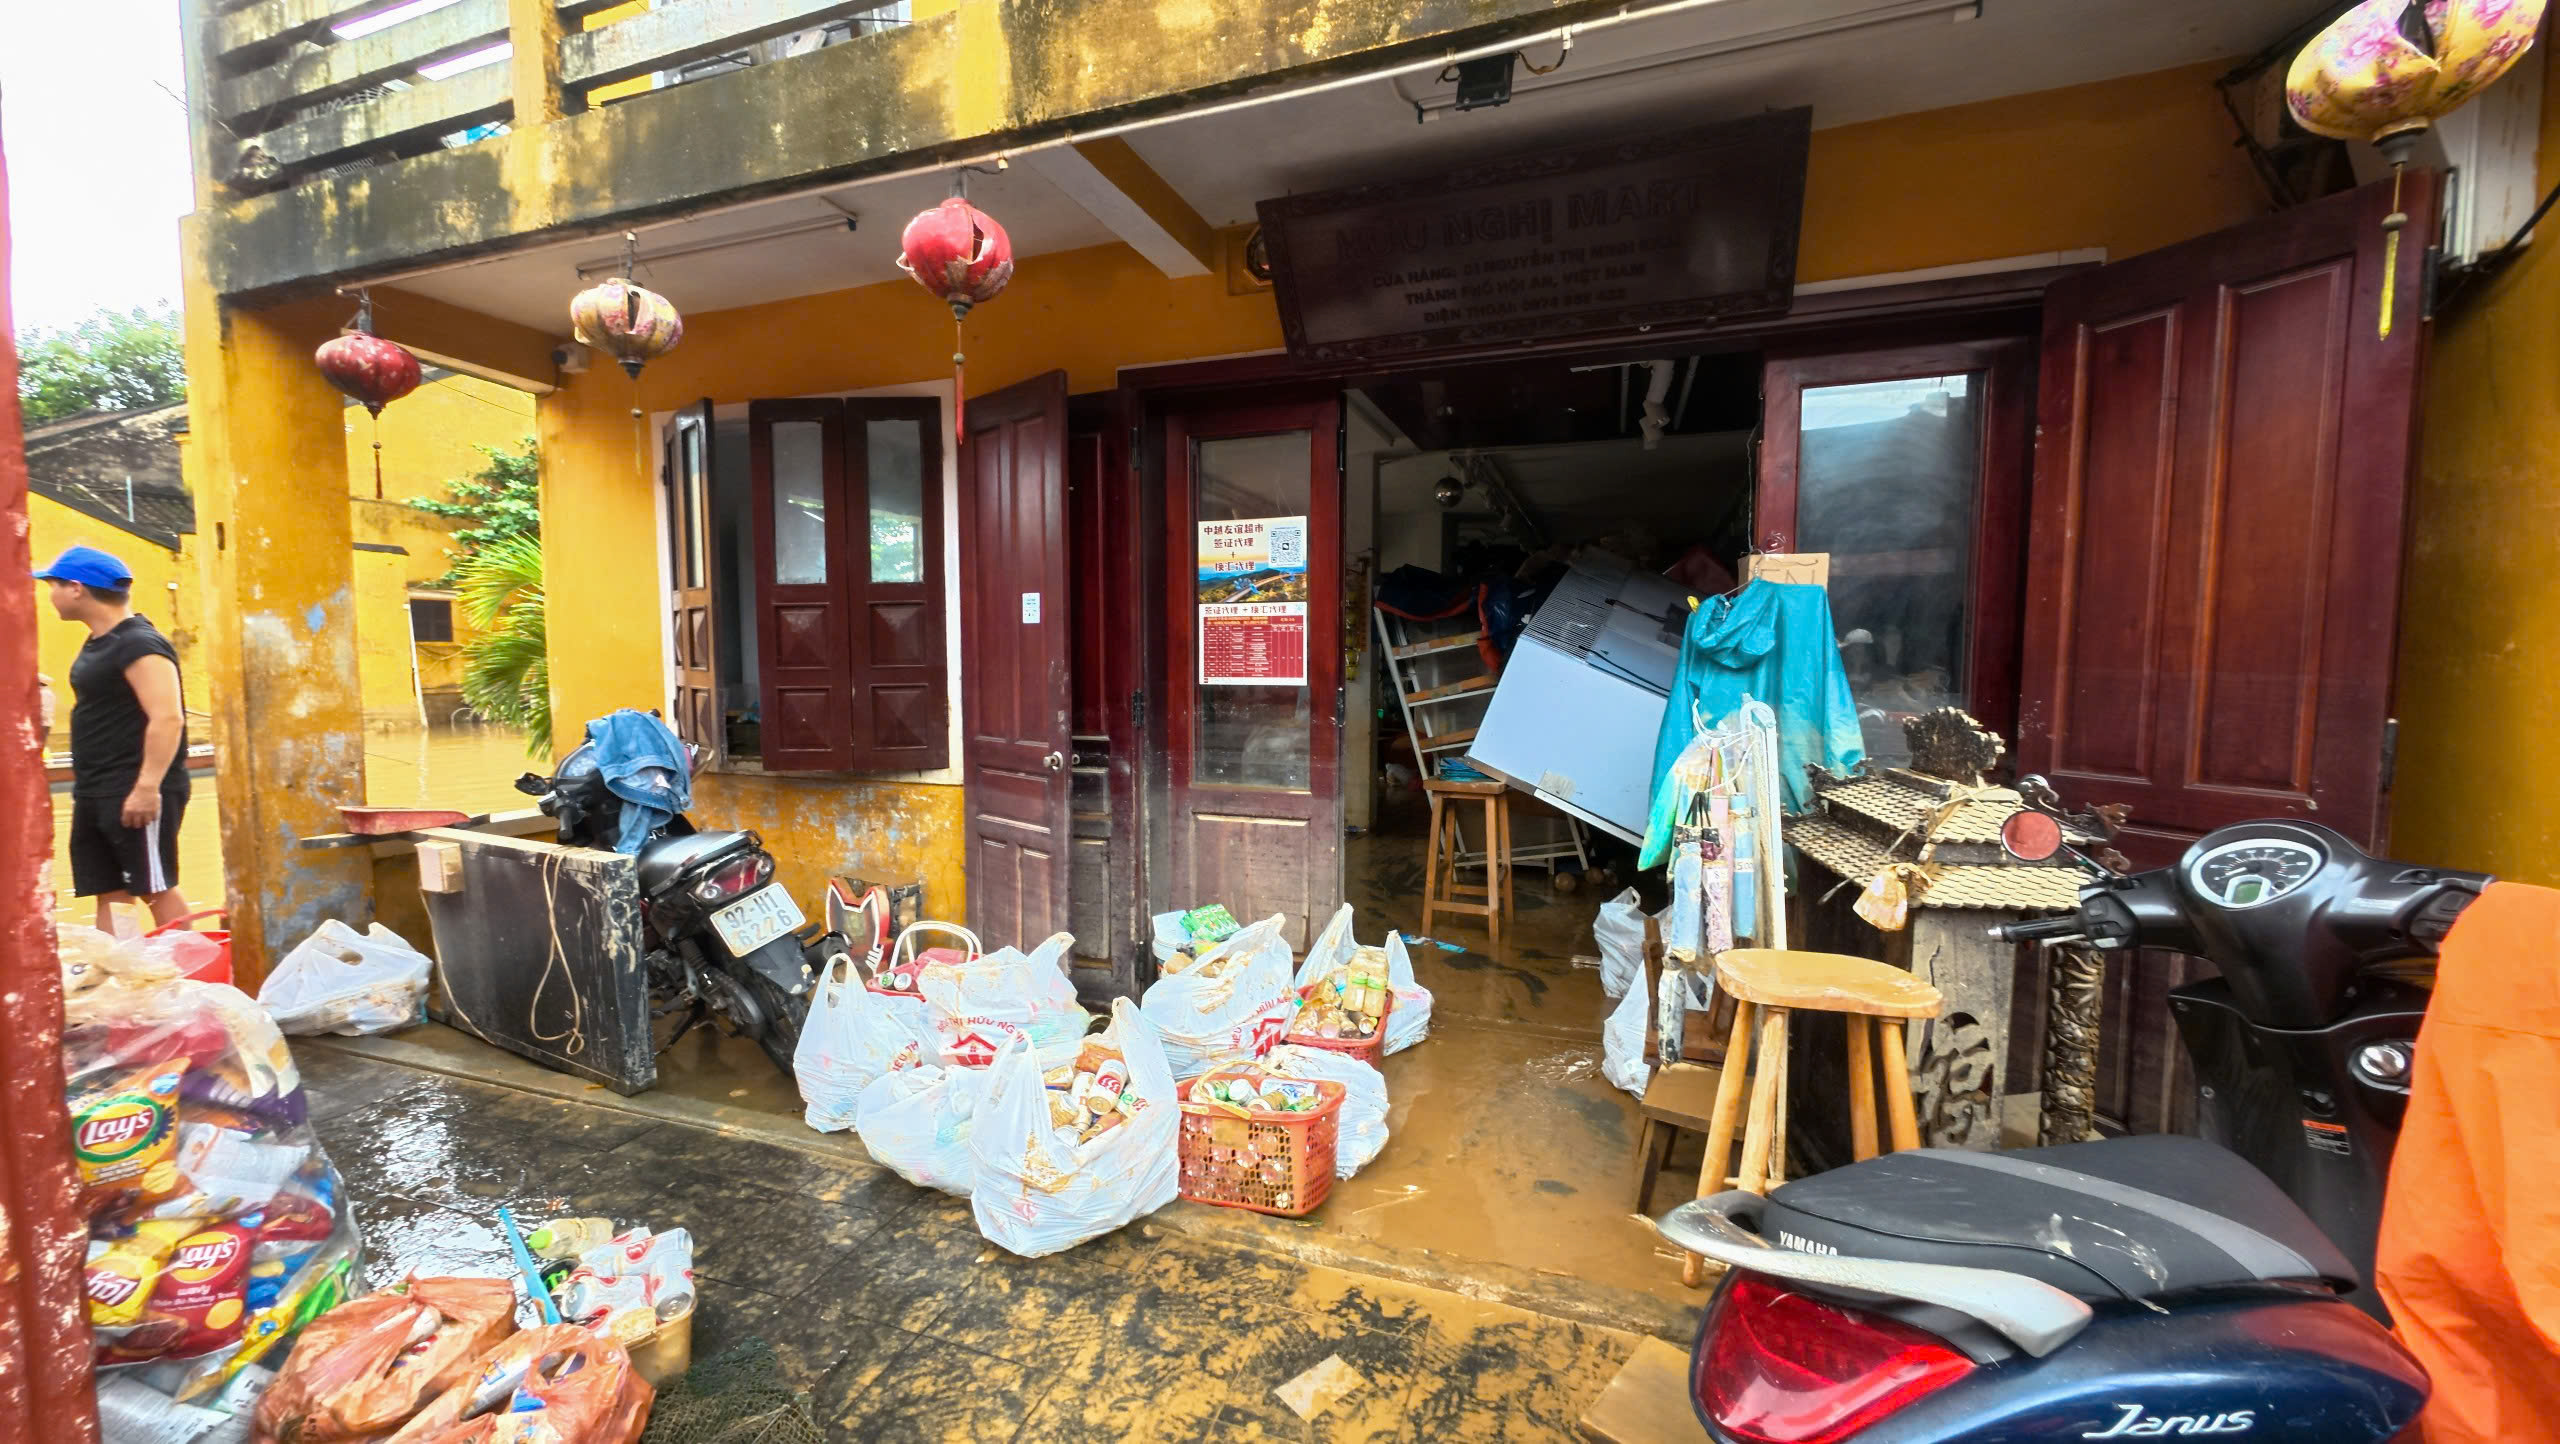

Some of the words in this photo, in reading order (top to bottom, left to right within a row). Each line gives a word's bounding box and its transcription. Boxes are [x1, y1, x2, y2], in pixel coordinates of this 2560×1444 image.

[1214, 538, 1254, 548] 签证代理
[724, 892, 779, 928] 92-H1
[967, 1014, 995, 1026] HỮU
[83, 1110, 152, 1146] Lay's
[2081, 1403, 2257, 1440] Janus
